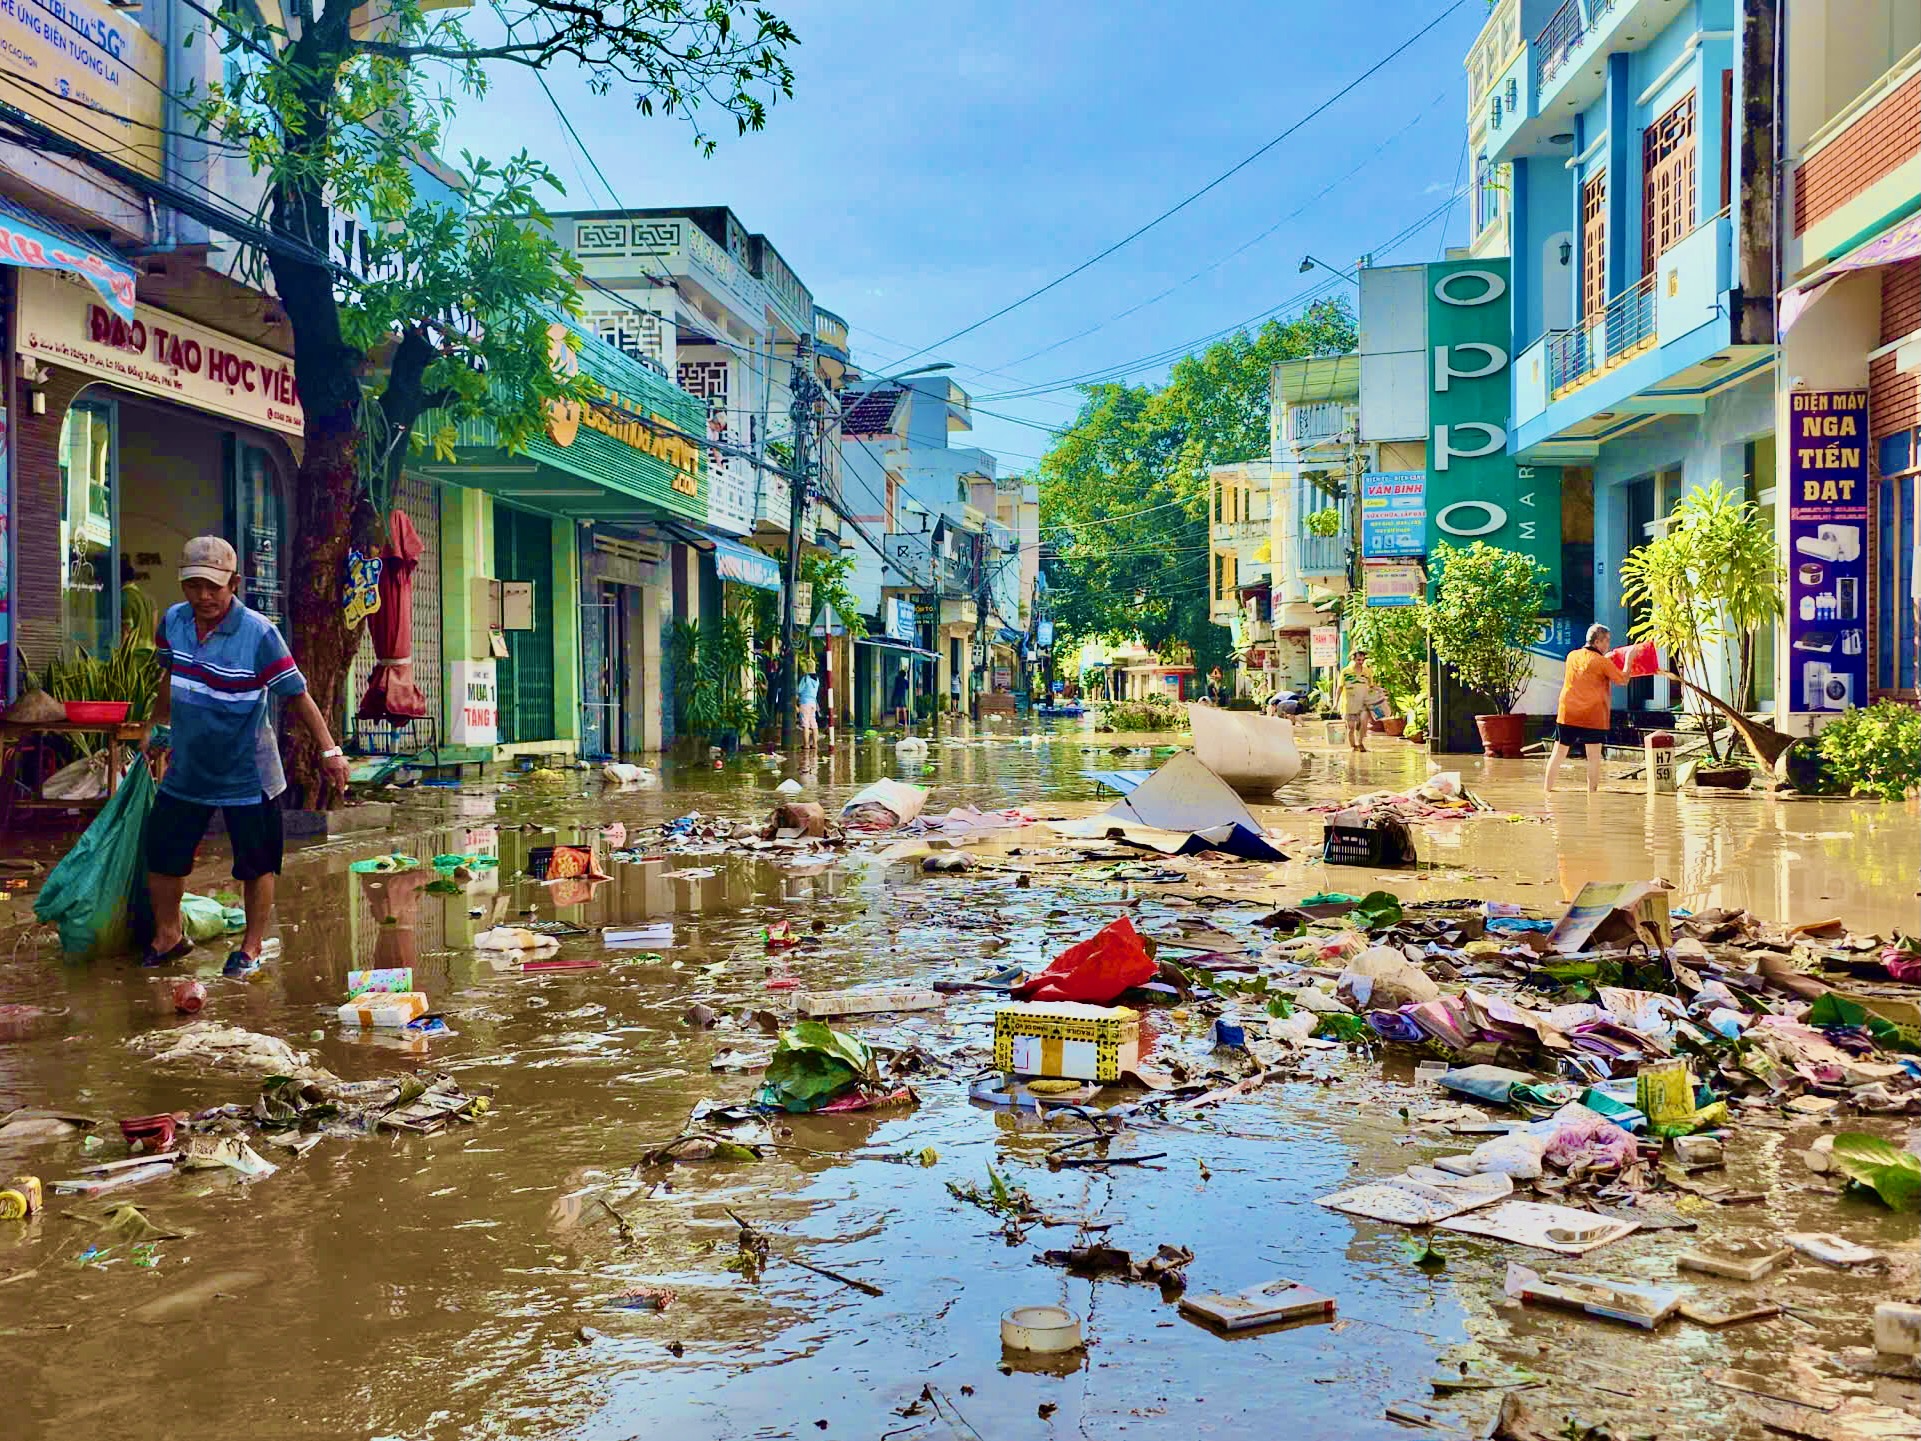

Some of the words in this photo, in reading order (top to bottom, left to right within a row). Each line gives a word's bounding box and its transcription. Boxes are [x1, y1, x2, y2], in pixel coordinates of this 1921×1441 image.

[105, 64, 119, 86] LAI
[153, 327, 202, 376] TẠO
[208, 348, 256, 395] HỌC
[1794, 393, 1828, 413] ĐIỆN
[1833, 392, 1866, 410] MÁY
[1802, 416, 1857, 437] NGA
[1798, 441, 1860, 468] TIẾN
[1803, 480, 1855, 504] ĐẠT
[468, 683, 488, 702] MUA
[490, 685, 495, 702] 1
